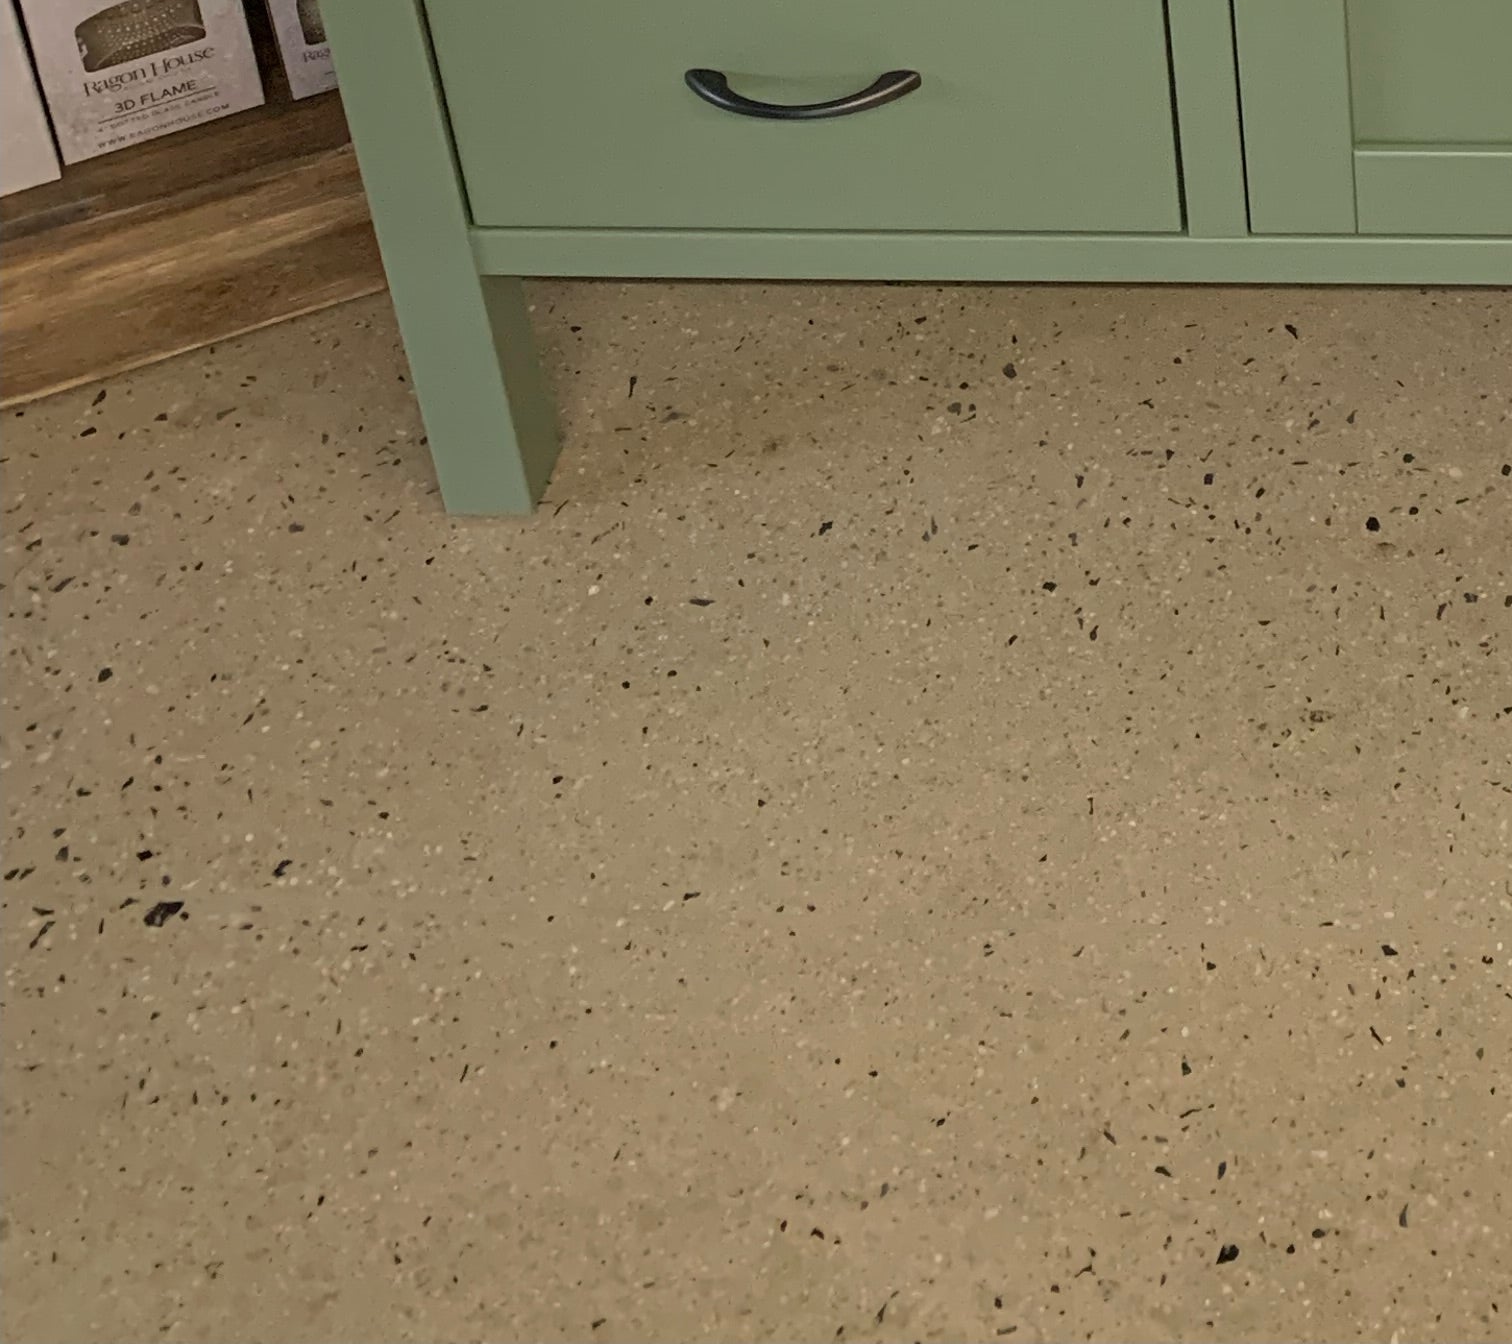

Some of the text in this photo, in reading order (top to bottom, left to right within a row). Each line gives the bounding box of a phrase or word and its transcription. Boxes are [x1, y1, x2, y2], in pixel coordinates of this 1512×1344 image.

[83, 67, 146, 97] Ragon
[151, 47, 215, 78] House
[115, 80, 197, 113] 3D FLAME
